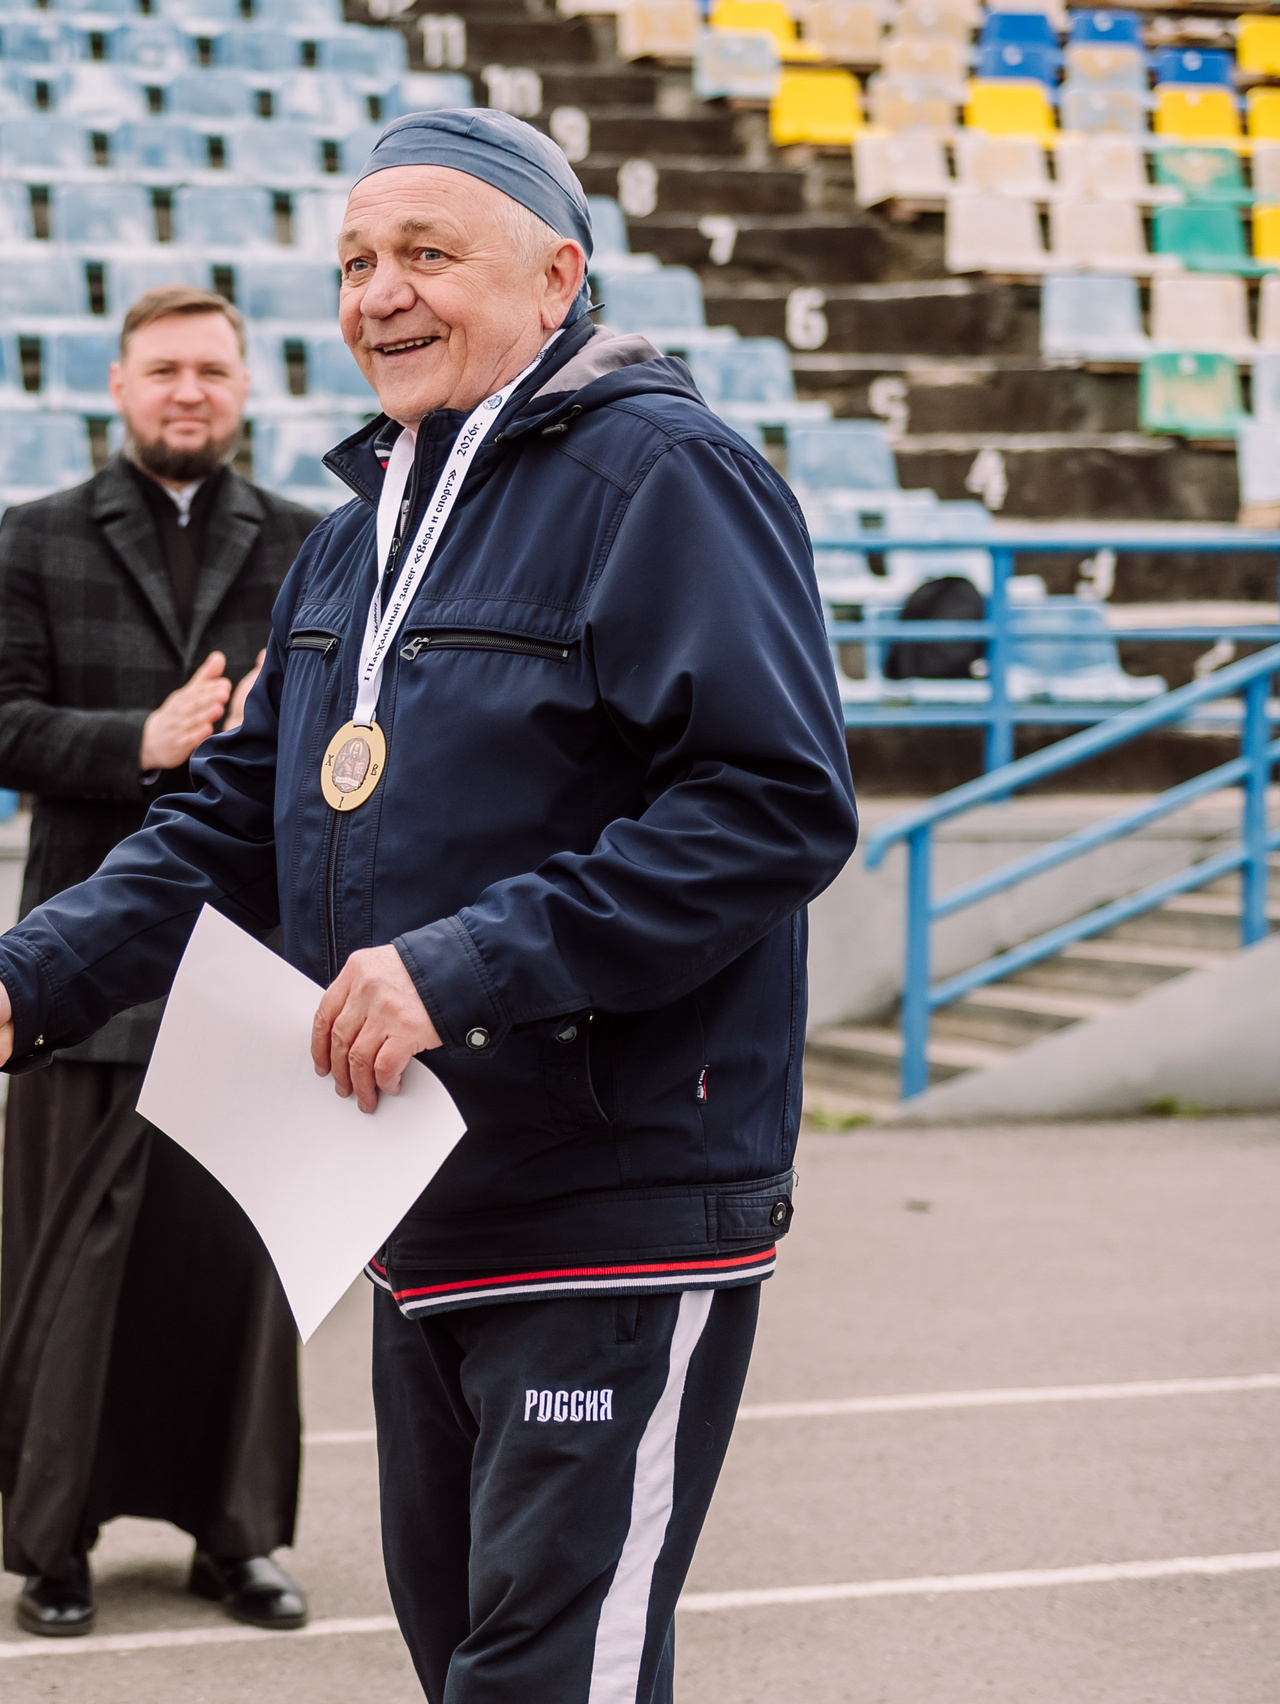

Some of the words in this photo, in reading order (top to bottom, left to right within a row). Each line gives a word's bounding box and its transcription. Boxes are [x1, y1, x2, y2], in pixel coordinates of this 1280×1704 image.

[418, 13, 467, 69] 11
[481, 64, 543, 118] 10
[549, 105, 590, 163] 9
[618, 158, 658, 218] 8
[698, 214, 738, 265] 7
[785, 287, 828, 350] 6
[869, 376, 908, 441] 5
[965, 449, 1008, 510] 4
[366, 602, 402, 673] Пасхальный
[413, 525, 436, 565] «Вера
[435, 469, 457, 514] спорт»
[456, 422, 483, 457] 2026г.
[524, 1388, 614, 1422] РОССИЯ
